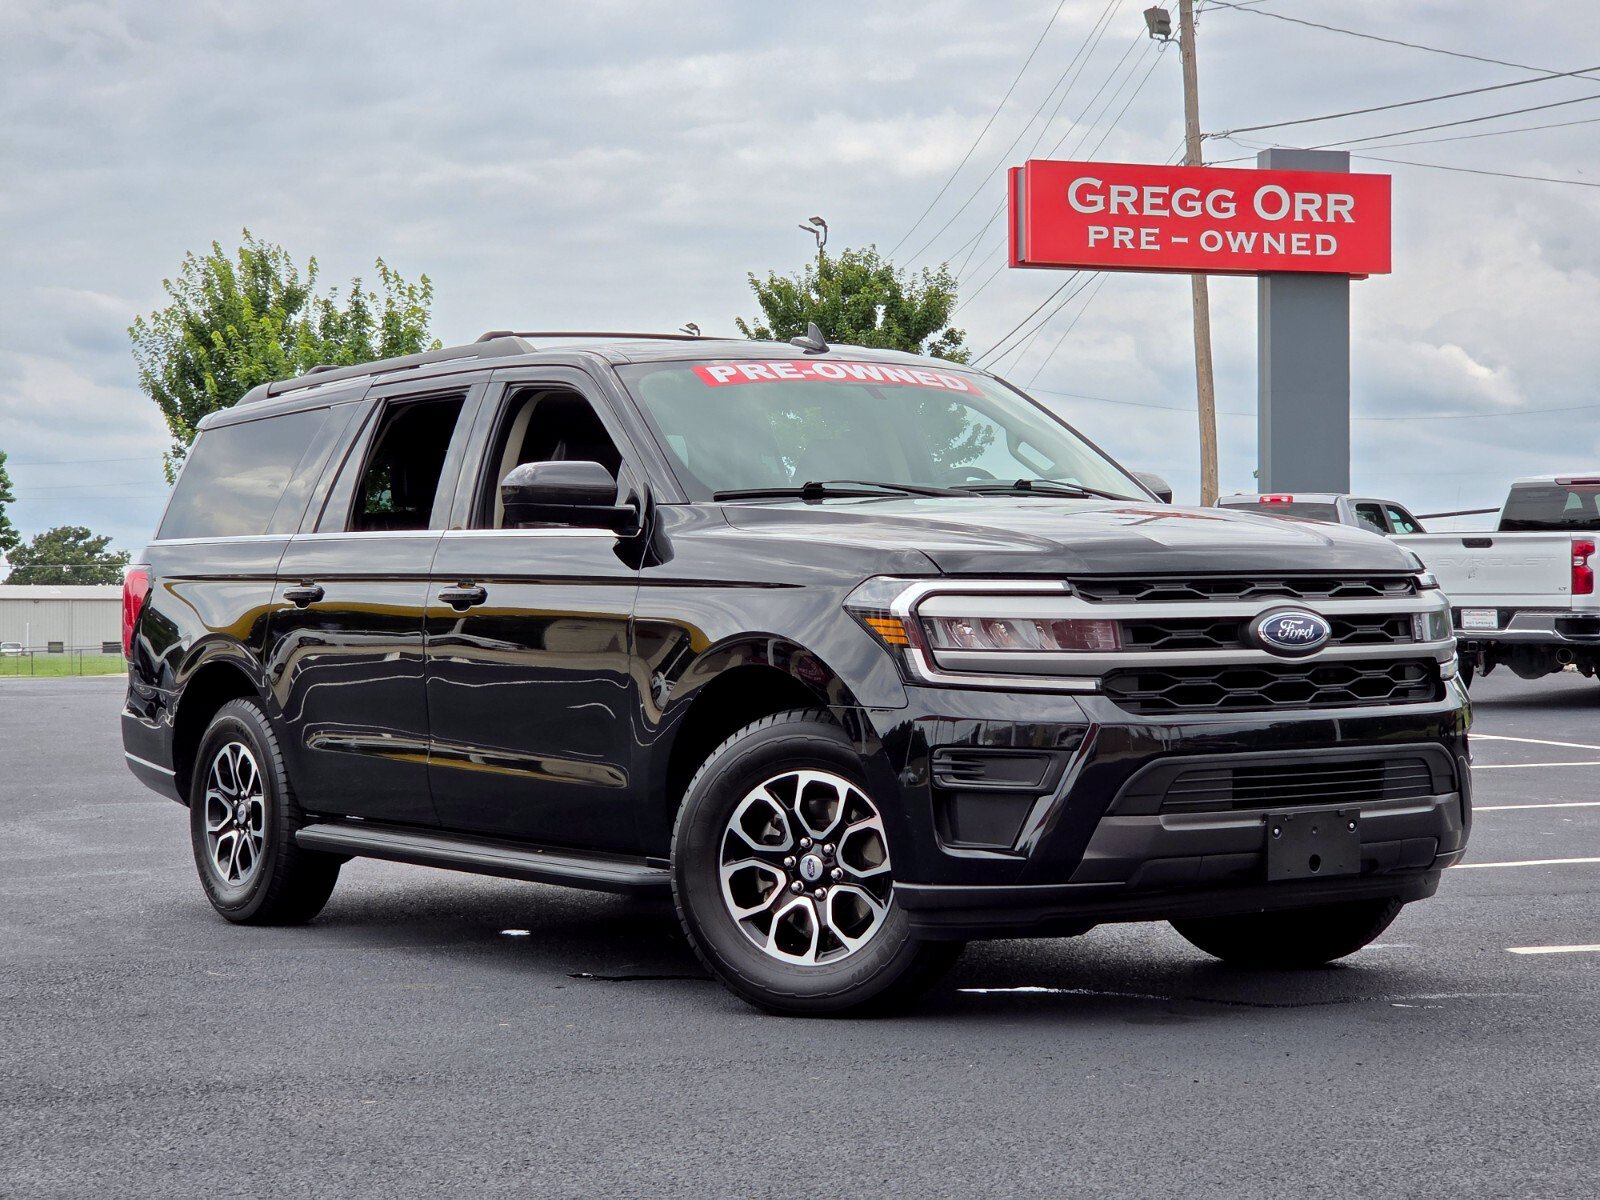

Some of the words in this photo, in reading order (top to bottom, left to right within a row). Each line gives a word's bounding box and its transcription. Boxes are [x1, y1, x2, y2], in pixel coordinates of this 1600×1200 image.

[1067, 176, 1237, 219] GREGG
[1254, 184, 1356, 224] ORR
[706, 362, 969, 391] PRE-OWNED
[1277, 619, 1315, 640] Ford
